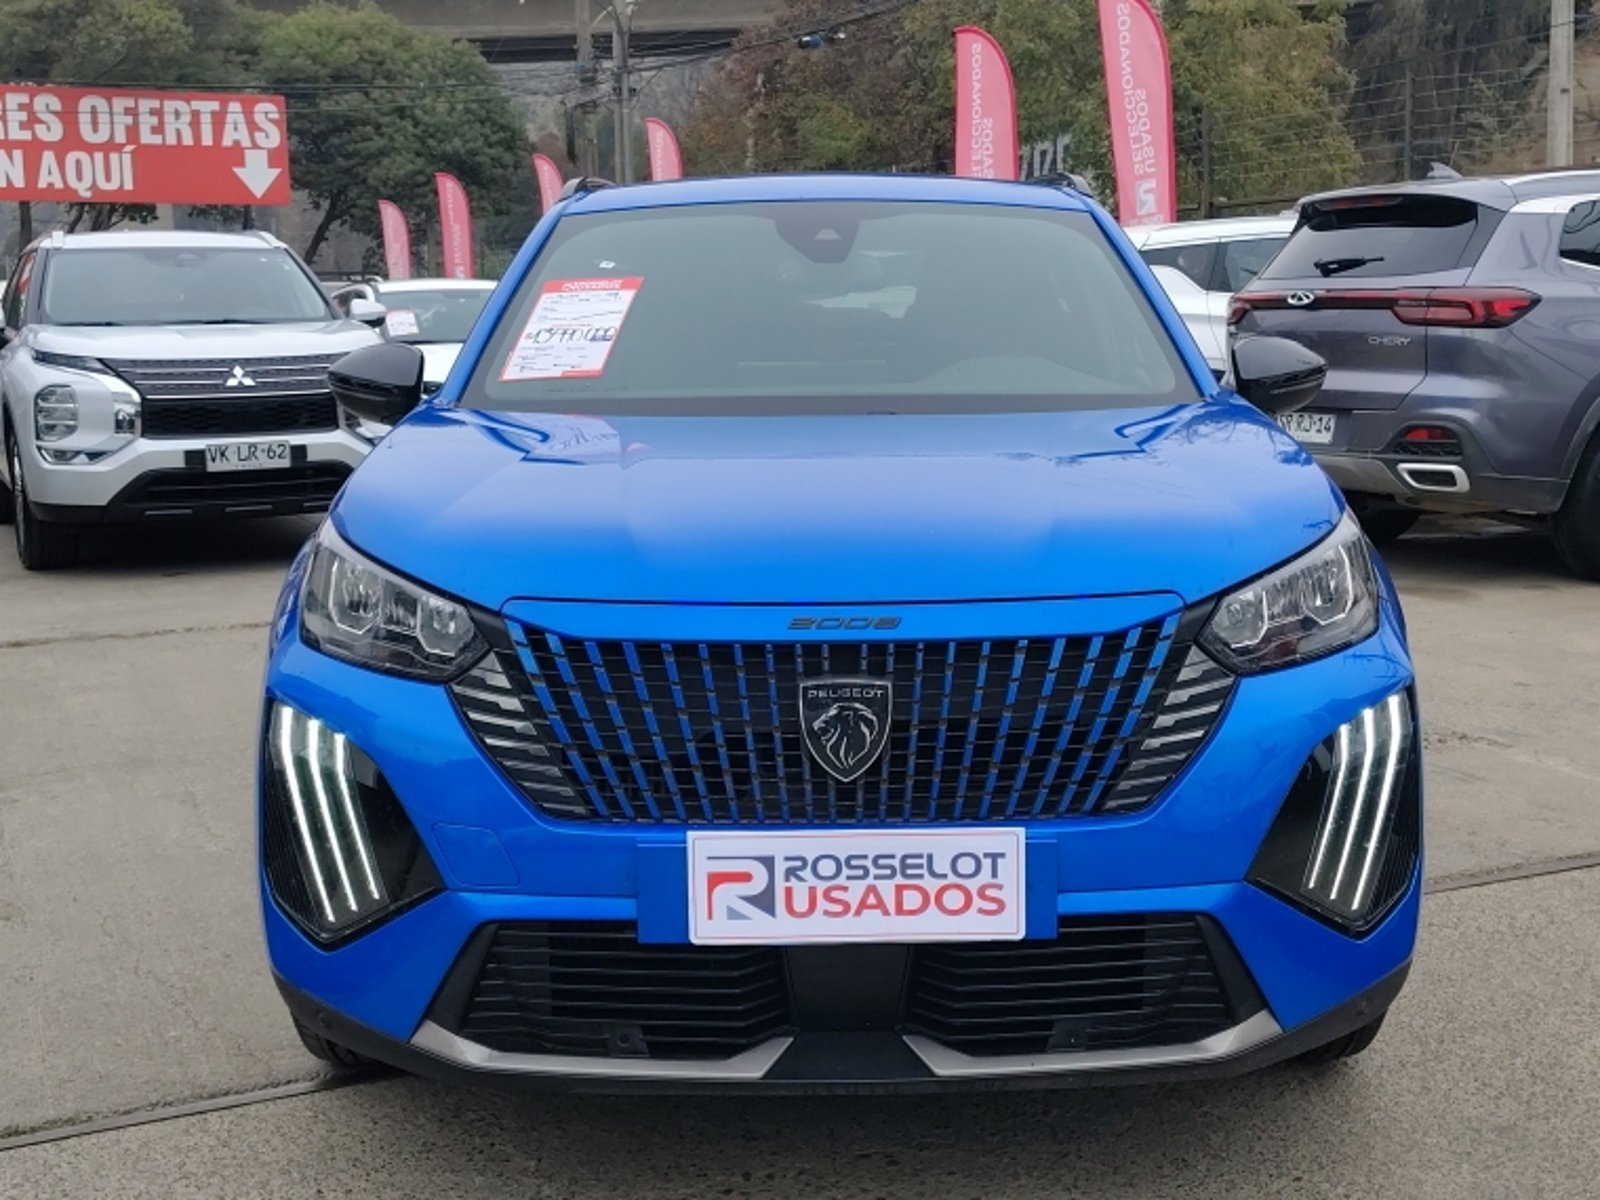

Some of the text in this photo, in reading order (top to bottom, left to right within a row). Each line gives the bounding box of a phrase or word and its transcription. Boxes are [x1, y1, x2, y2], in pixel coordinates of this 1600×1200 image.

[0, 92, 281, 149] ES OFERTAS
[37, 145, 137, 198] AQUÍ
[1368, 335, 1411, 346] CHERY
[787, 617, 901, 630] 2008
[807, 688, 885, 699] PEUGEOT
[783, 852, 1007, 882] ROSSELOT
[783, 883, 1007, 919] USADOS
